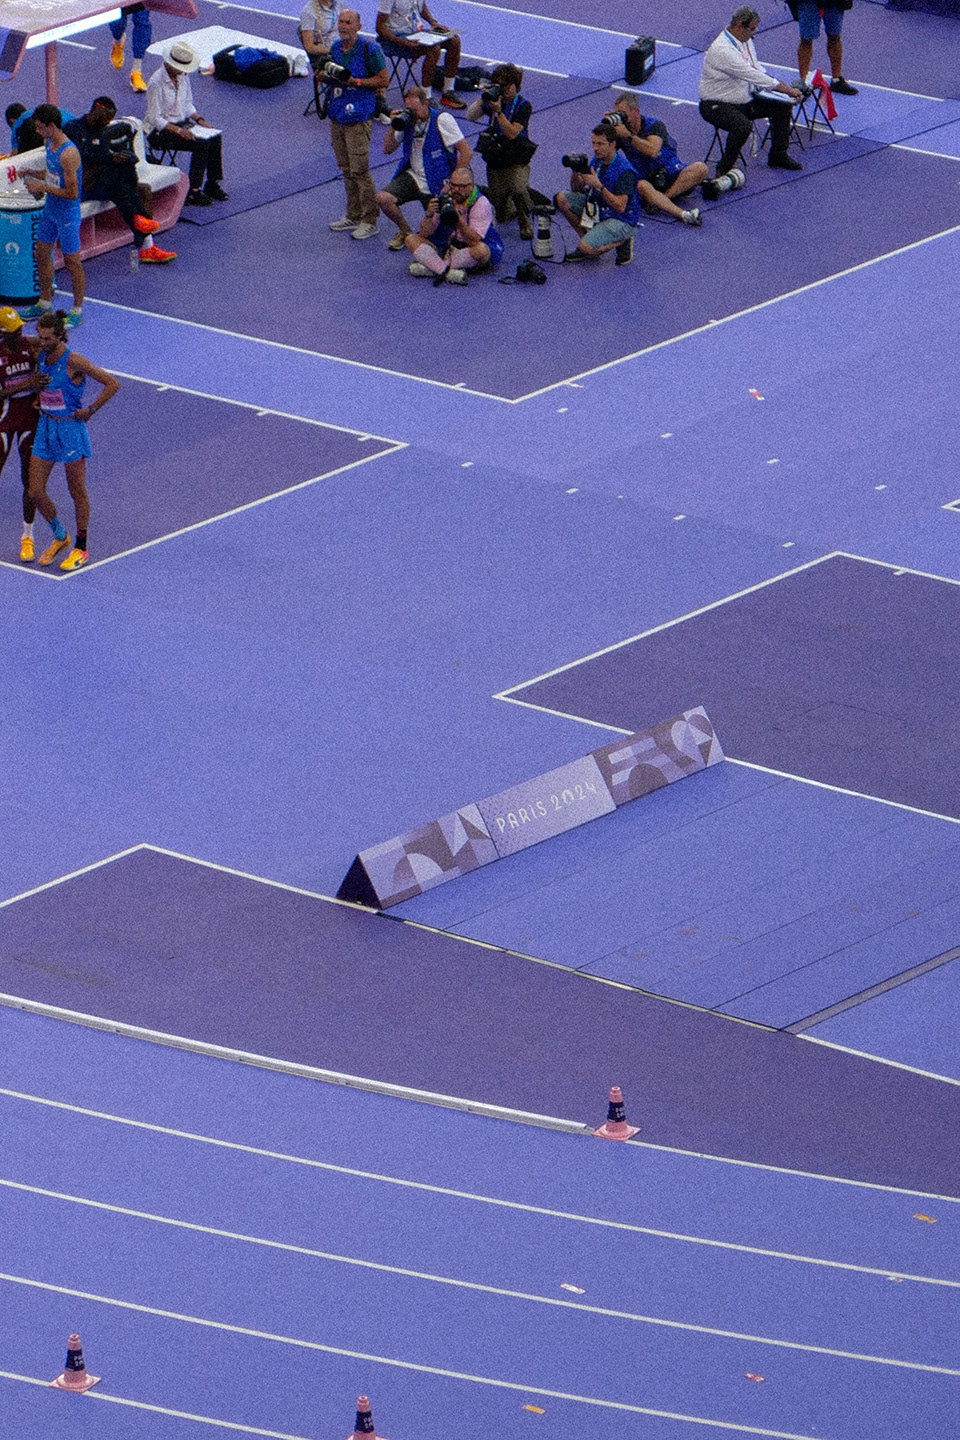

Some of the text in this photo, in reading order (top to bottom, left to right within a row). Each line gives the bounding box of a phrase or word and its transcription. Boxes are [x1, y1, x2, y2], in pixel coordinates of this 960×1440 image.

[6, 362, 30, 376] QATAR
[496, 782, 597, 833] PARIS 2024
